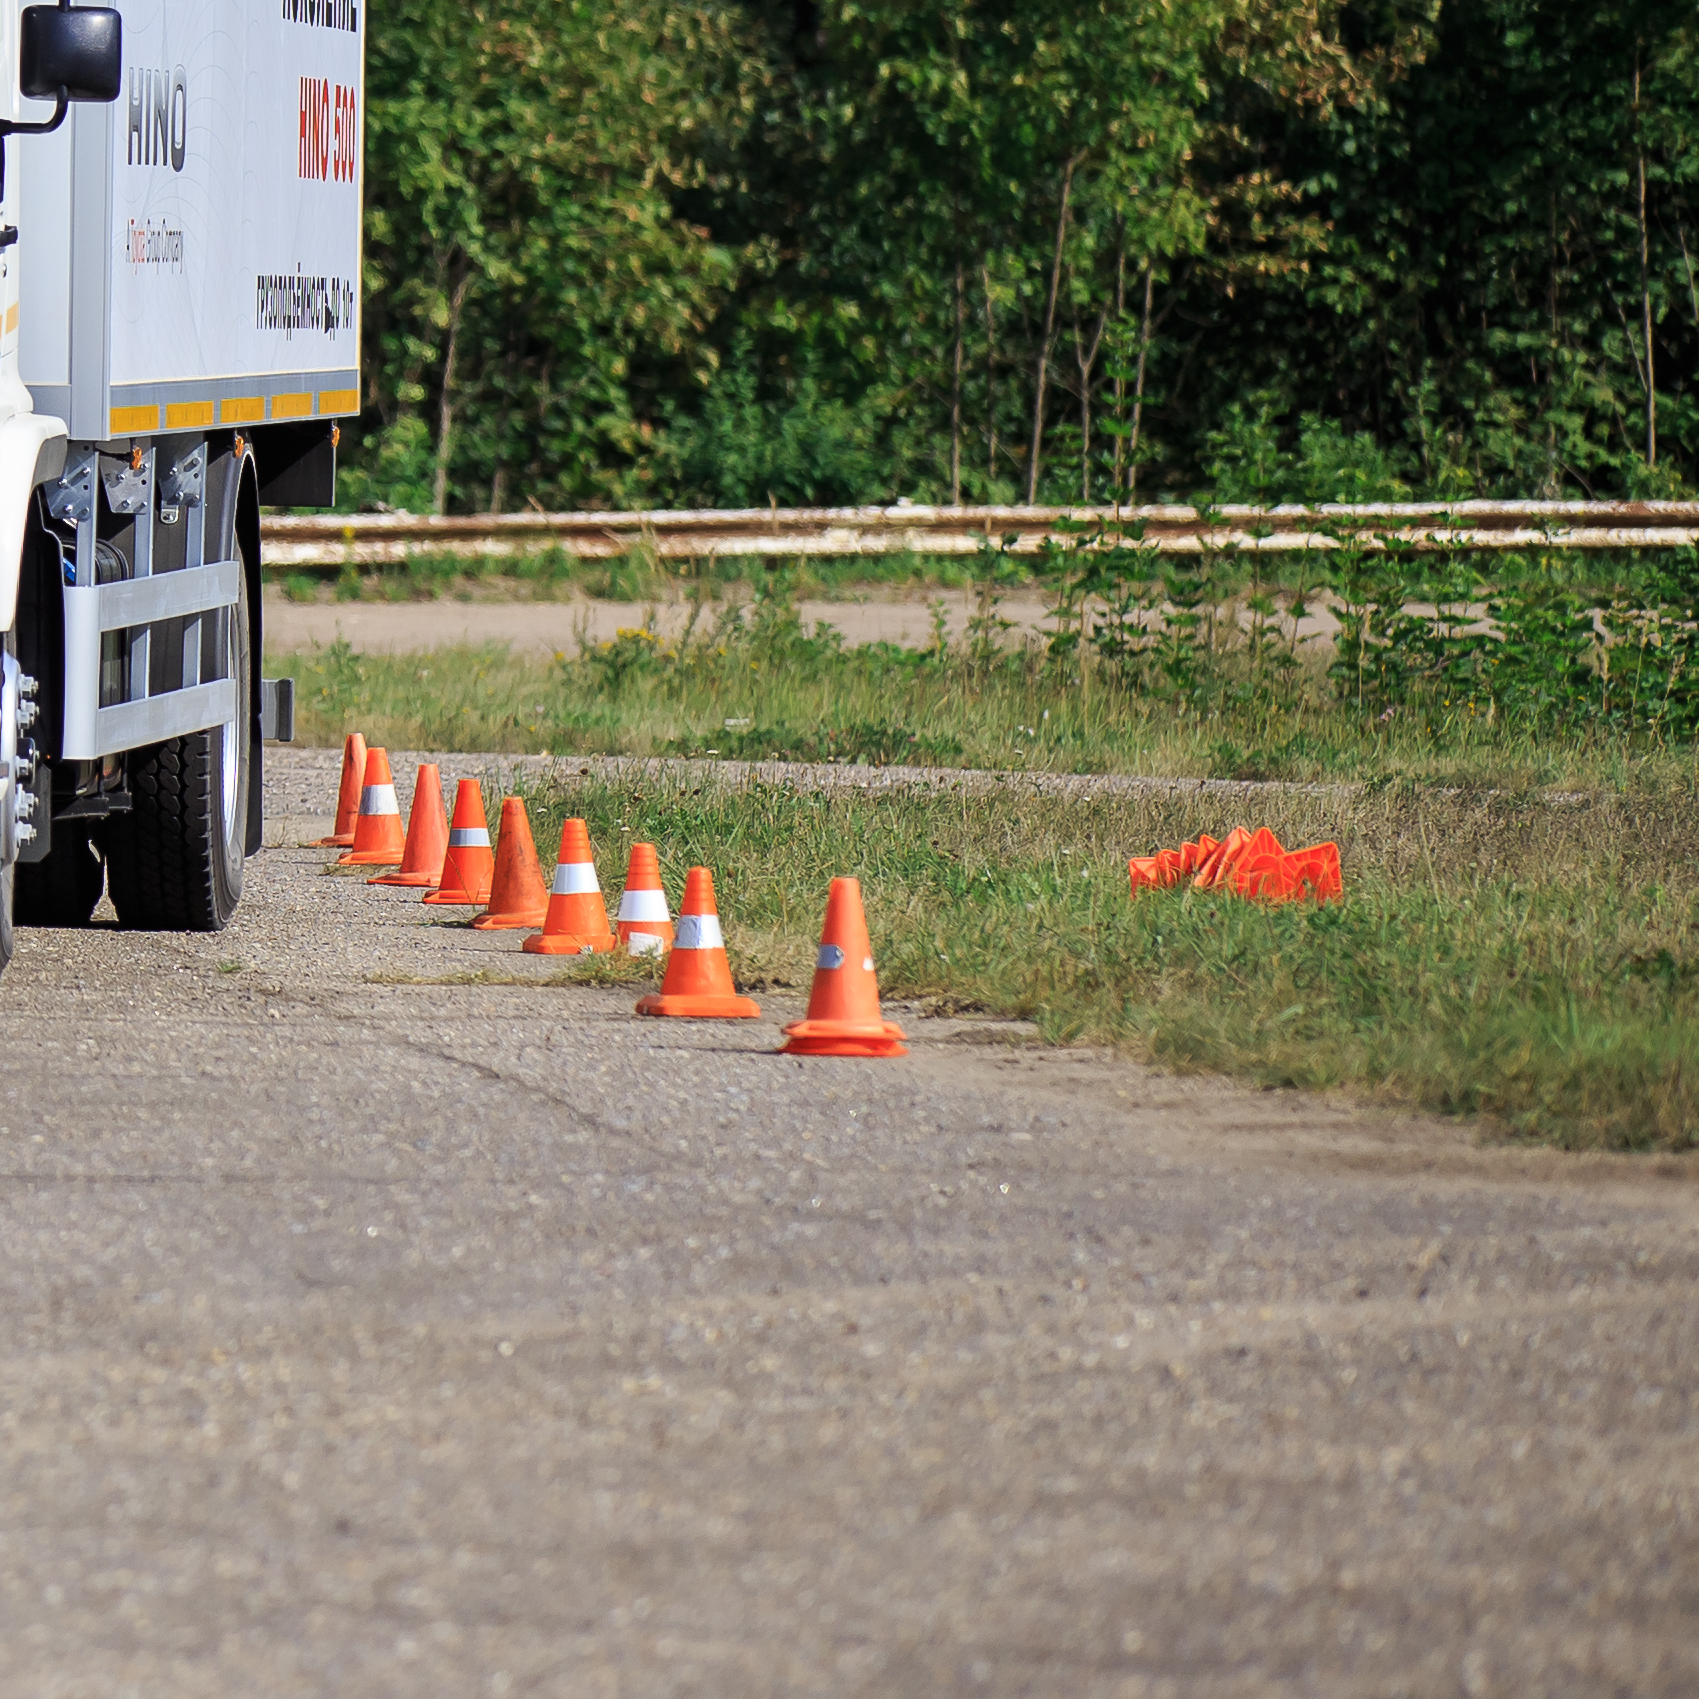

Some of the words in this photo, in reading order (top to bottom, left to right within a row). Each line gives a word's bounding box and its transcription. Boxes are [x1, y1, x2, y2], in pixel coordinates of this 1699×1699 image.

[127, 64, 187, 172] HINO
[298, 75, 330, 182] HINO
[333, 84, 356, 183] 500
